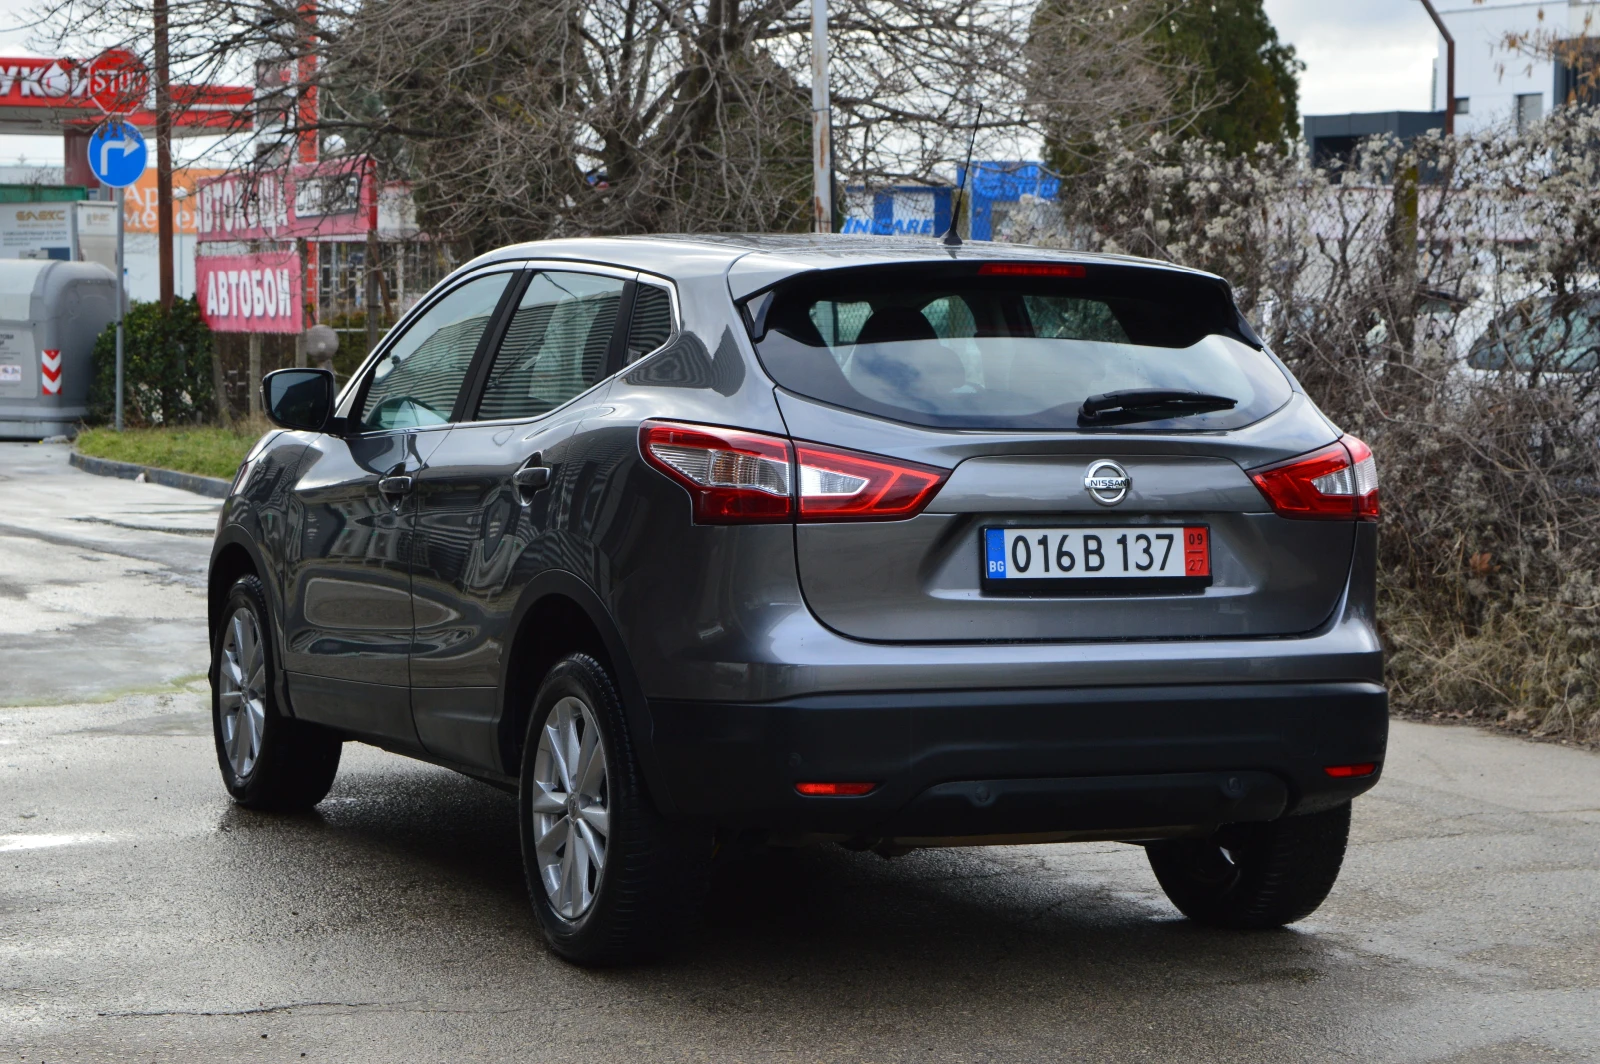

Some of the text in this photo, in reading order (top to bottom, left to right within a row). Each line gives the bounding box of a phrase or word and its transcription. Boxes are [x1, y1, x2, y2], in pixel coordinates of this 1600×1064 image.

[206, 267, 291, 317] АВТОБОИ
[1090, 479, 1128, 488] NISSAN
[1188, 533, 1203, 545] 09
[989, 560, 1005, 573] BG
[1188, 559, 1204, 572] 27
